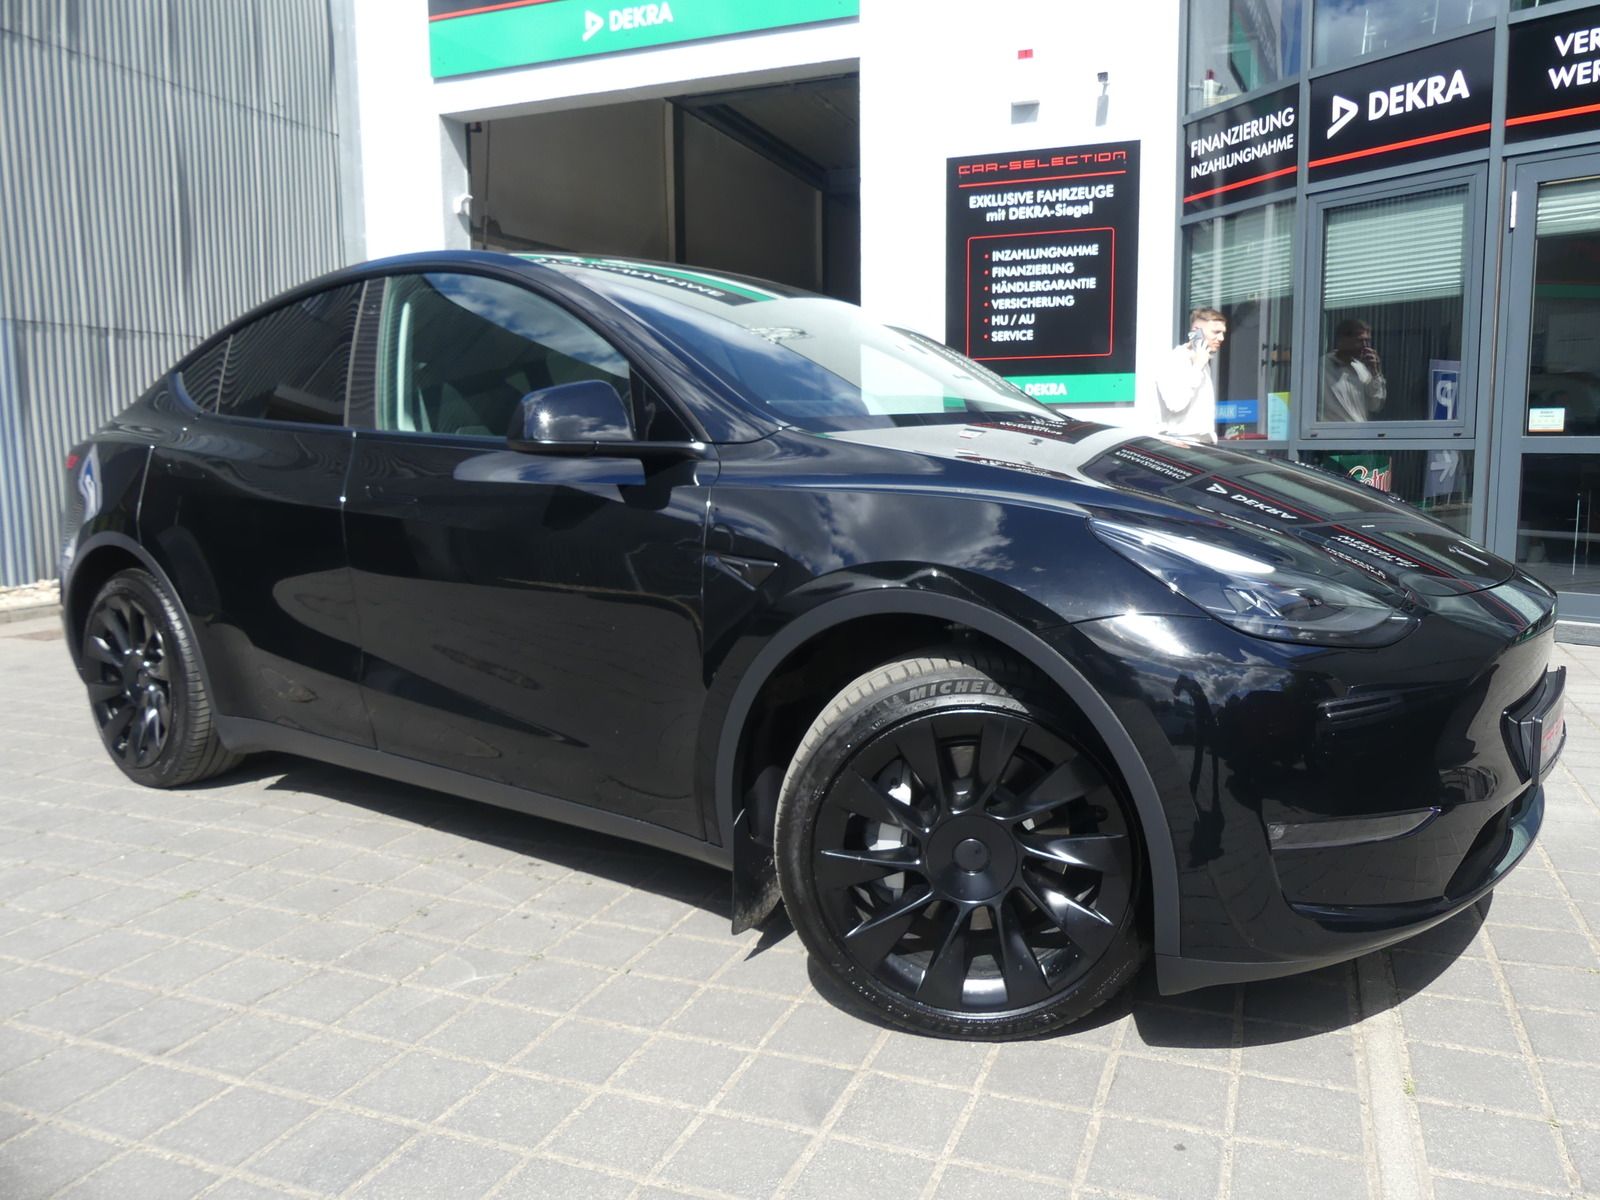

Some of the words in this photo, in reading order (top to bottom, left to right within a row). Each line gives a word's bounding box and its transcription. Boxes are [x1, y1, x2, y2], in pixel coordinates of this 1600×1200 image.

[609, 2, 673, 32] DEKRA
[1554, 27, 1600, 57] VER
[1367, 69, 1470, 121] DEKRA
[1190, 107, 1295, 158] FINANZIERUNG
[958, 150, 1127, 176] CAR-SELECTION
[1190, 133, 1294, 179] INZAHLUNGNAHME
[969, 190, 1034, 209] EXKLUSIVE
[1036, 184, 1114, 204] FAHRZEUGE
[986, 208, 1006, 222] mit
[1008, 201, 1093, 221] DEKRA-Siegel
[992, 244, 1099, 262] INZAHLUNGNAHME
[992, 262, 1075, 278] FINANZIERUNG
[992, 277, 1097, 294] HÄNDLERGARANTIE
[991, 295, 1075, 310] VERSICHERUNG
[991, 314, 1009, 326] HU
[1018, 313, 1035, 325] AU
[991, 329, 1034, 342] SERVICE
[1025, 383, 1069, 397] DEKRA
[909, 679, 1012, 703] MICHEL
